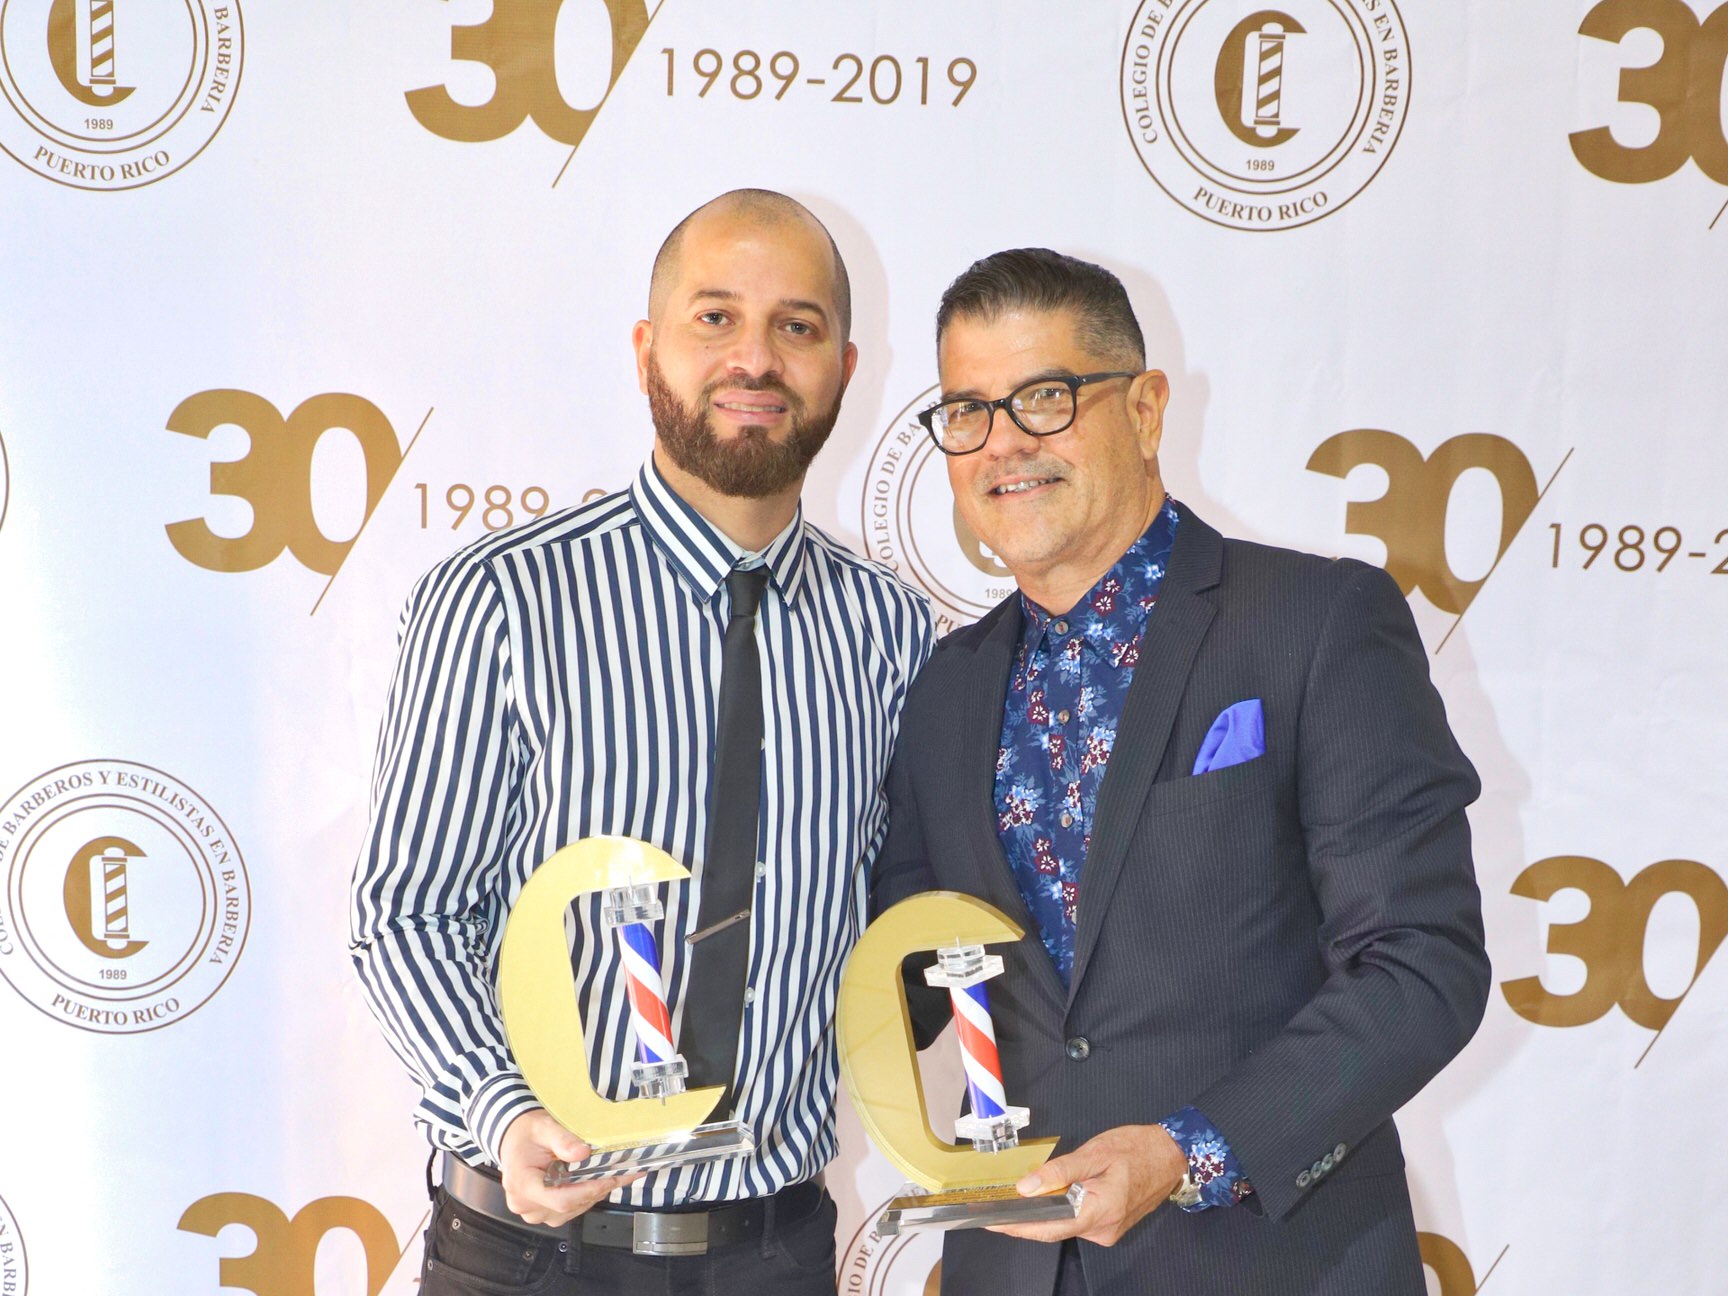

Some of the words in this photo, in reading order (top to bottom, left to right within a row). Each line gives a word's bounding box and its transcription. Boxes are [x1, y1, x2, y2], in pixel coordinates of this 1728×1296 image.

[1142, 9, 1164, 41] DE
[1373, 10, 1395, 43] EN
[200, 6, 232, 113] BARBERIA
[661, 48, 977, 108] 1989-2019
[1132, 44, 1158, 144] COLEGIO
[1362, 47, 1399, 155] BARBERIA
[84, 118, 114, 130] 1989
[33, 145, 115, 182] PUERTO
[119, 150, 170, 181] RICO
[1246, 159, 1275, 171] 1989
[1193, 186, 1272, 222] PUERTO
[1278, 191, 1328, 221] RICO
[881, 447, 902, 476] DE
[98, 771, 111, 785] Y
[3, 771, 93, 836] BARBEROS
[116, 771, 214, 838] ESTILISTAS
[209, 837, 231, 865] EN
[209, 868, 240, 966] BARBERIA
[98, 969, 127, 980] 1989
[51, 993, 129, 1025] PUERTO
[134, 997, 181, 1025] RICO
[853, 1244, 874, 1271] DE
